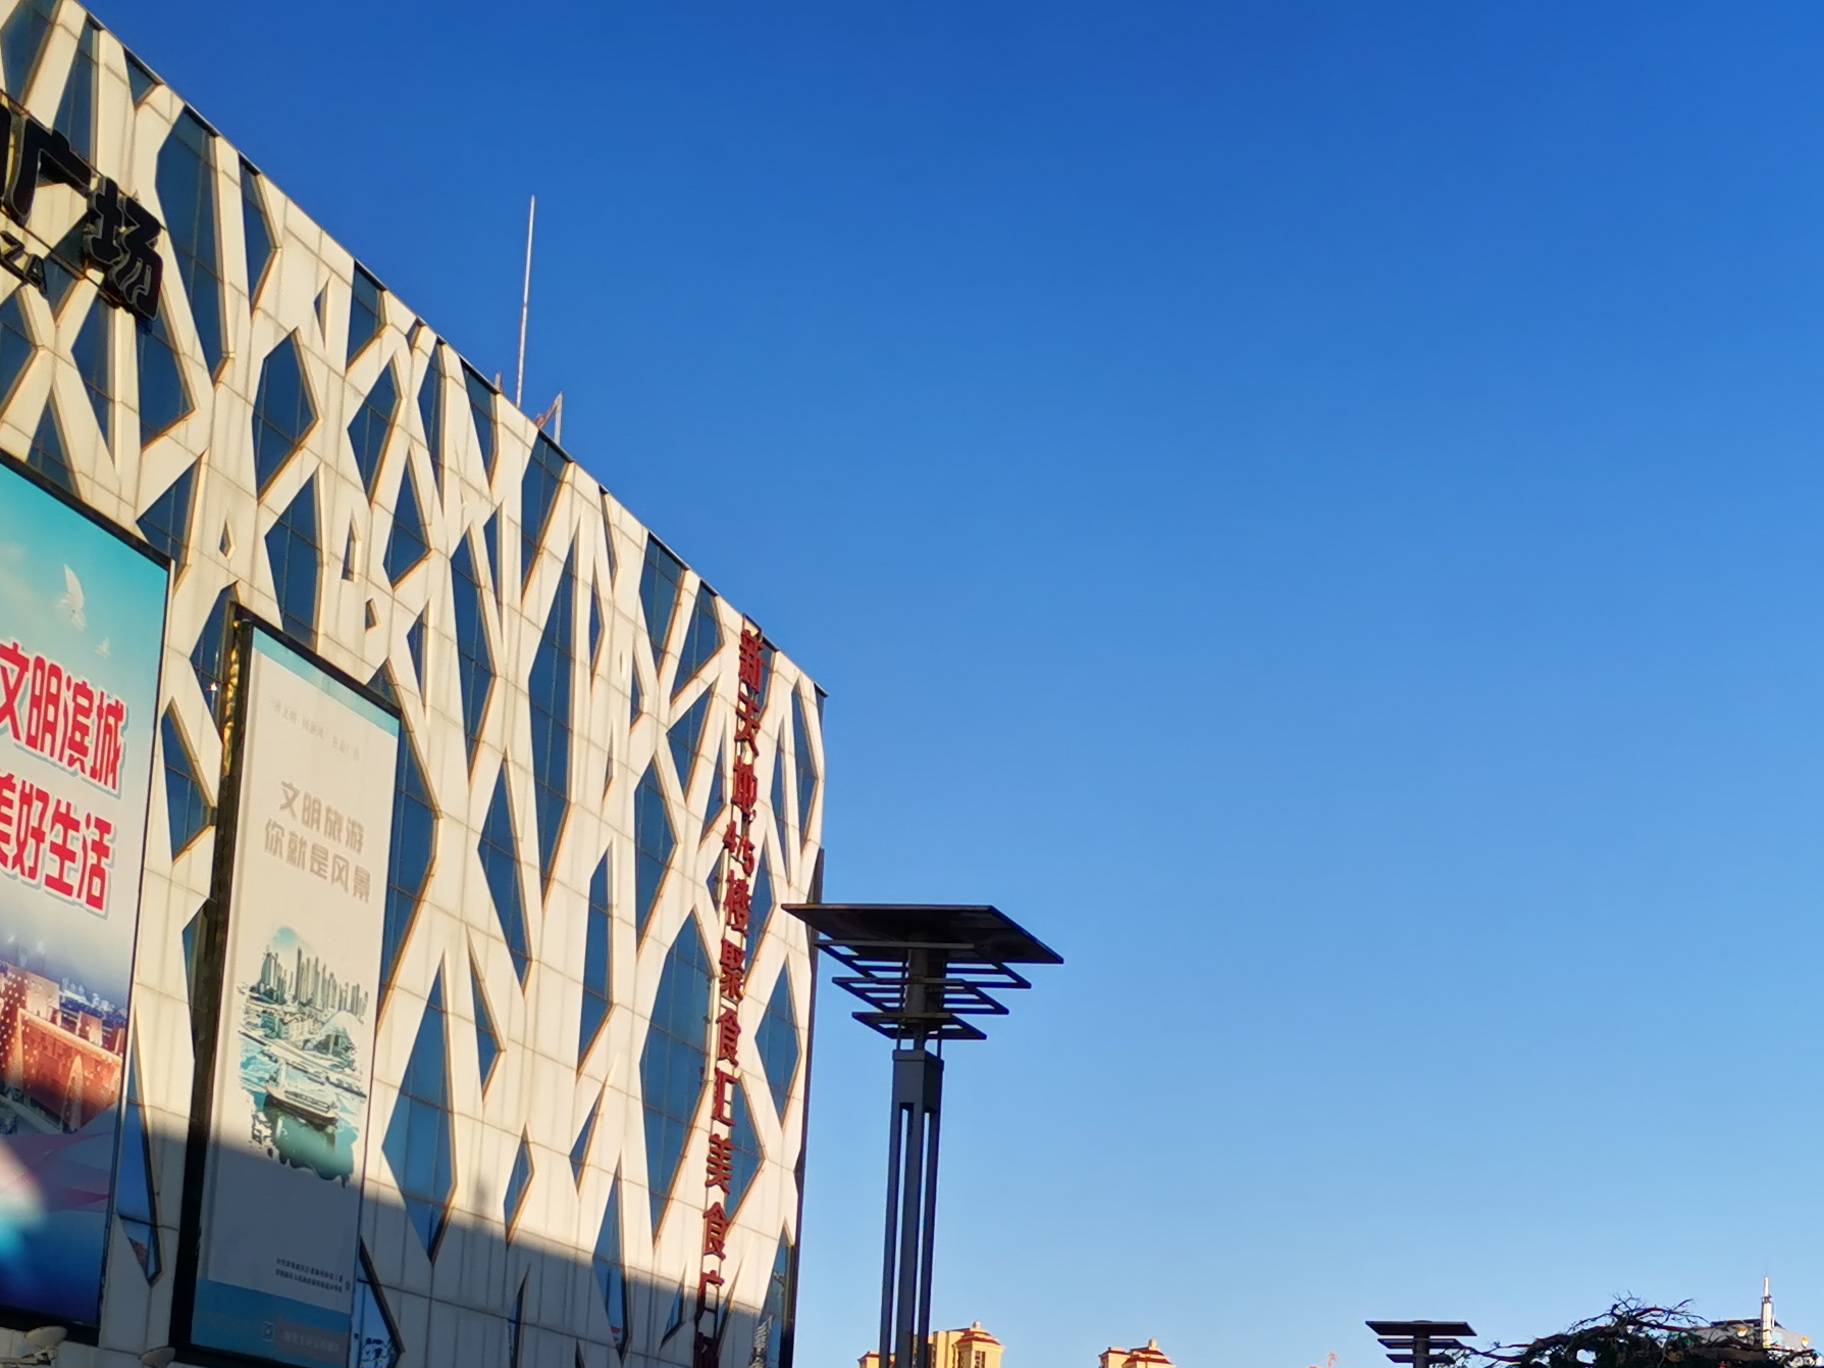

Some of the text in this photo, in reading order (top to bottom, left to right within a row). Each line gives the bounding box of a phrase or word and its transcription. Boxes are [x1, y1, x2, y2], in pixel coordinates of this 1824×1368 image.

[0, 104, 162, 322] 广场
[0, 640, 126, 793] 文明滨城
[264, 818, 372, 904] 你就是风景
[279, 780, 365, 854] 文明旅游
